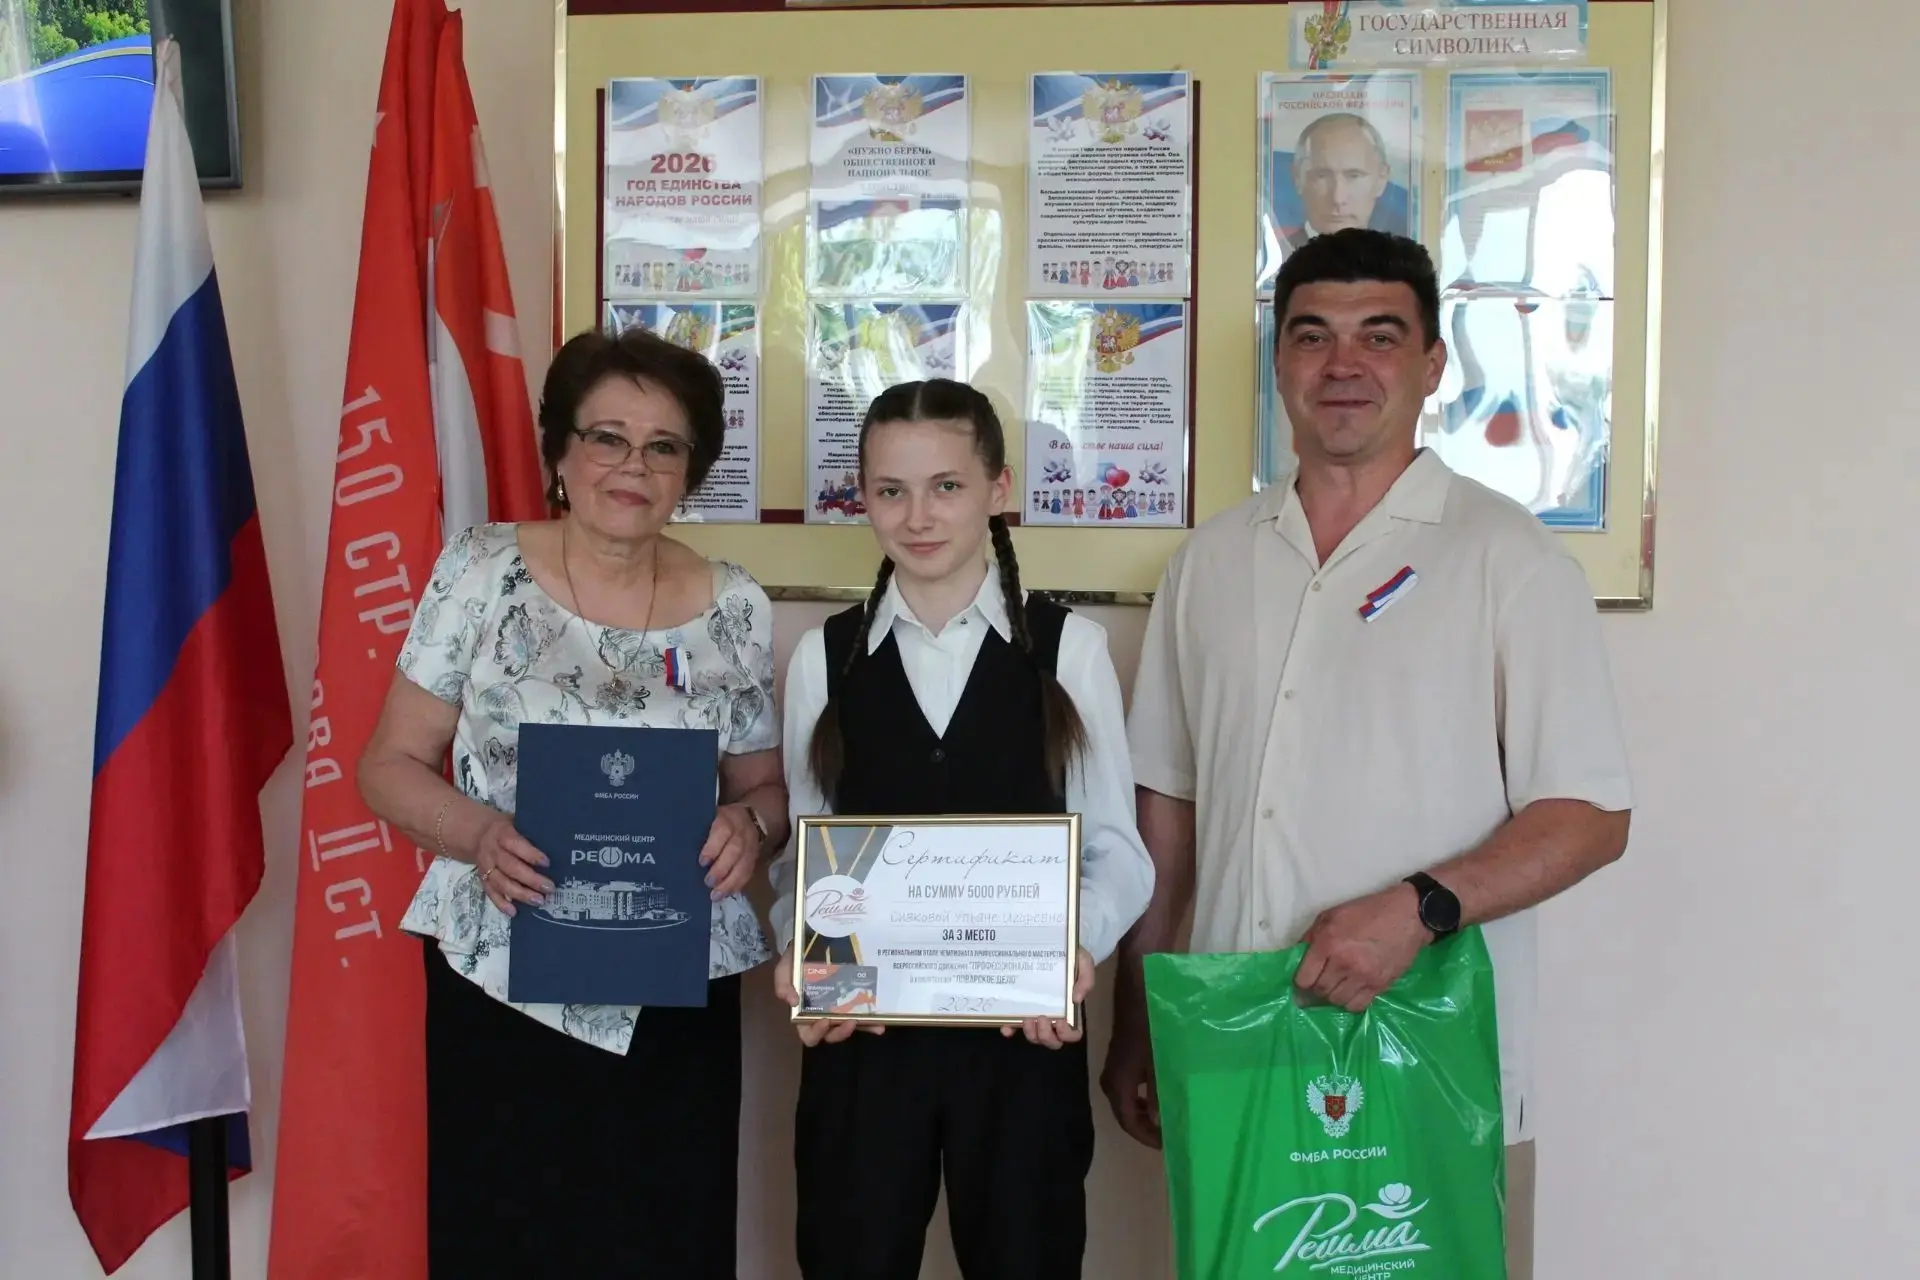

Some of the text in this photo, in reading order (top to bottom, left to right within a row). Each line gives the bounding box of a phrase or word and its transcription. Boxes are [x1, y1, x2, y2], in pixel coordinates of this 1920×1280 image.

[1359, 11, 1568, 33] ГОСУДАРСТВЕННАЯ
[1395, 37, 1531, 55] СИМВОЛИКА
[651, 153, 718, 174] 2026
[843, 158, 936, 167] ОБЩЕСТВЕННОЕ И
[627, 180, 656, 192] ГОД
[615, 195, 752, 207] НАРОДОВ РОССИИ
[333, 384, 404, 507] 150
[1048, 439, 1058, 450] В
[1108, 441, 1135, 451] наша
[1136, 441, 1164, 452] сила!
[574, 833, 656, 843] МЕДИЦИНСКИЙ ЦЕНТР
[882, 830, 1067, 880] Сертификат
[908, 883, 1040, 899] НА СУММУ 5000 РУБЛЕЙ
[942, 929, 996, 941] ЗА 3 МЕСТО
[807, 967, 827, 975] DNS
[1290, 1146, 1387, 1163] ФМБА РОССИИ
[1253, 1193, 1427, 1273] Решма
[1330, 1258, 1415, 1275] МЕДИЦИНСКИЙ
